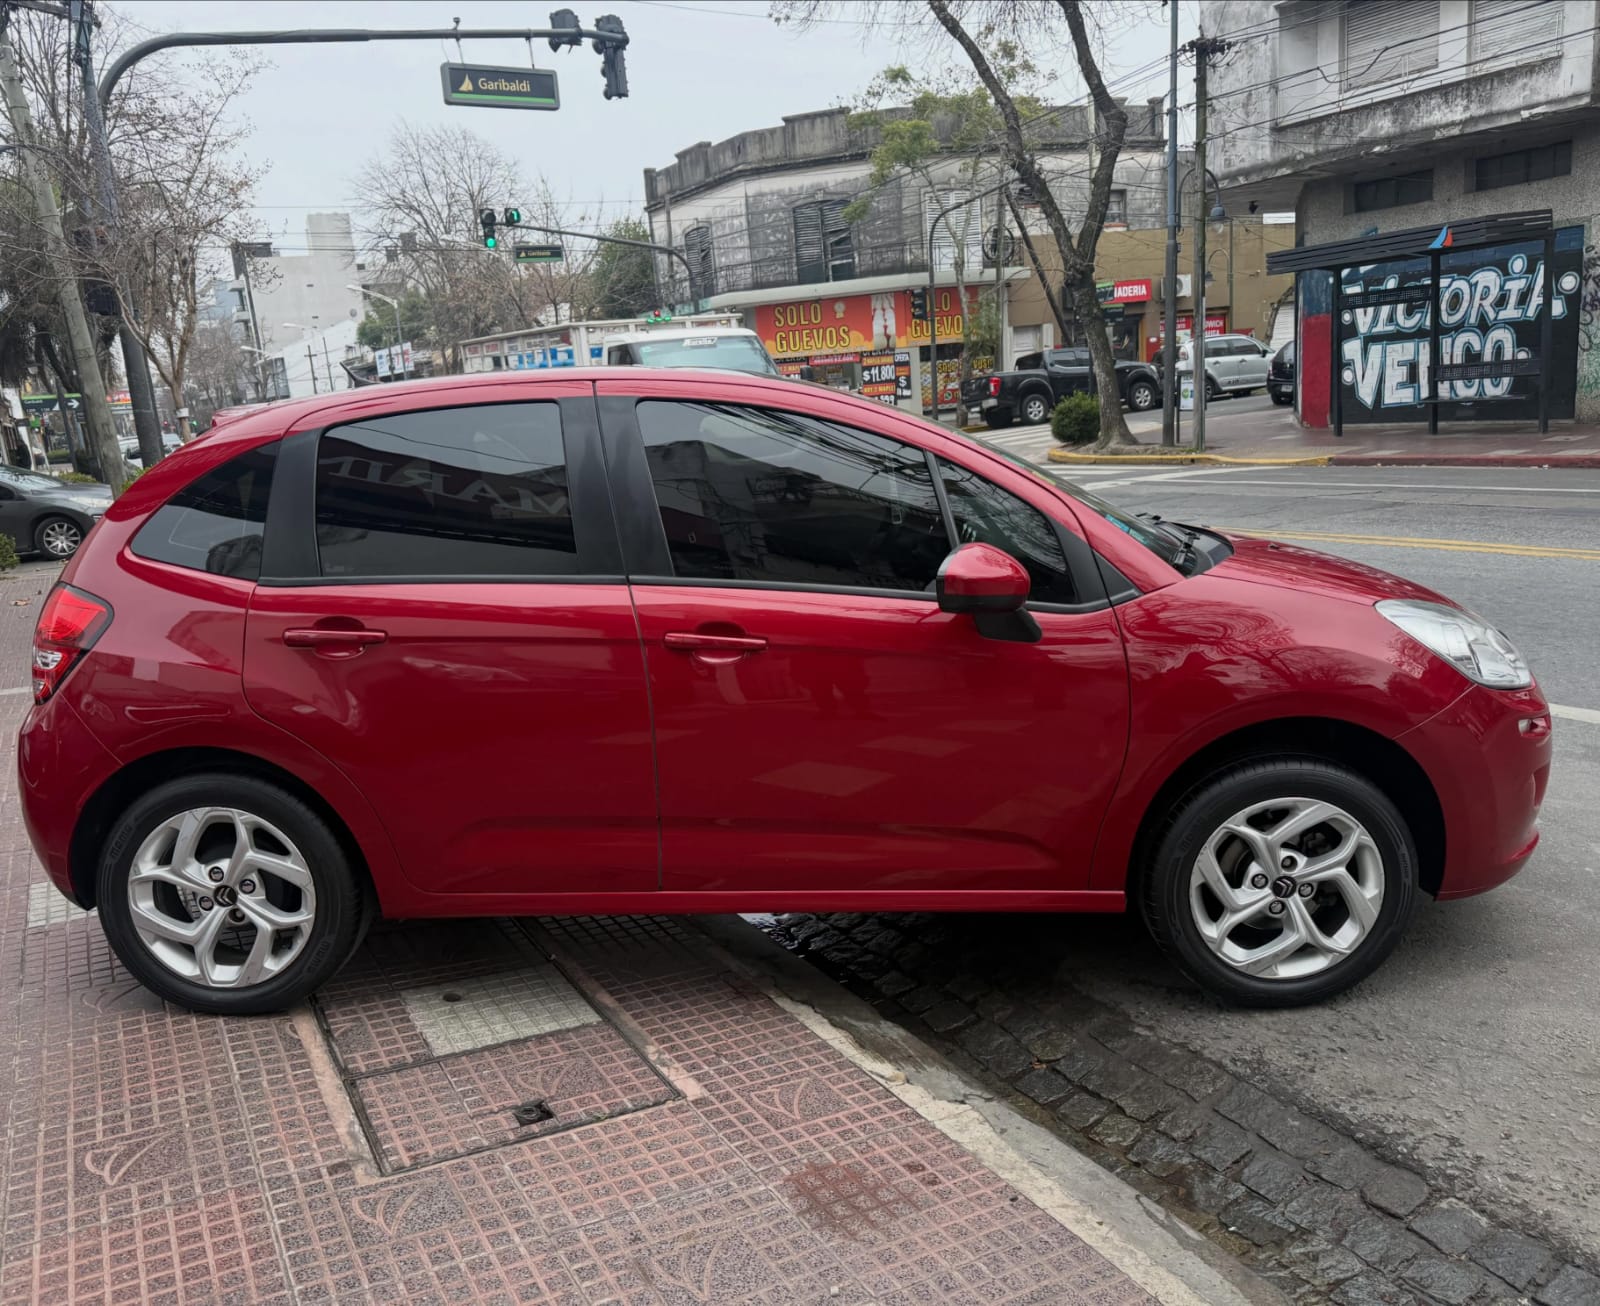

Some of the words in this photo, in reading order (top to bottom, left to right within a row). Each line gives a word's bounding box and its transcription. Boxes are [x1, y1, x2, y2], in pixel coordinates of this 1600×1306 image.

[478, 77, 531, 92] Garibaldi
[774, 303, 822, 328] SOLO
[775, 325, 851, 353] GUEVOS
